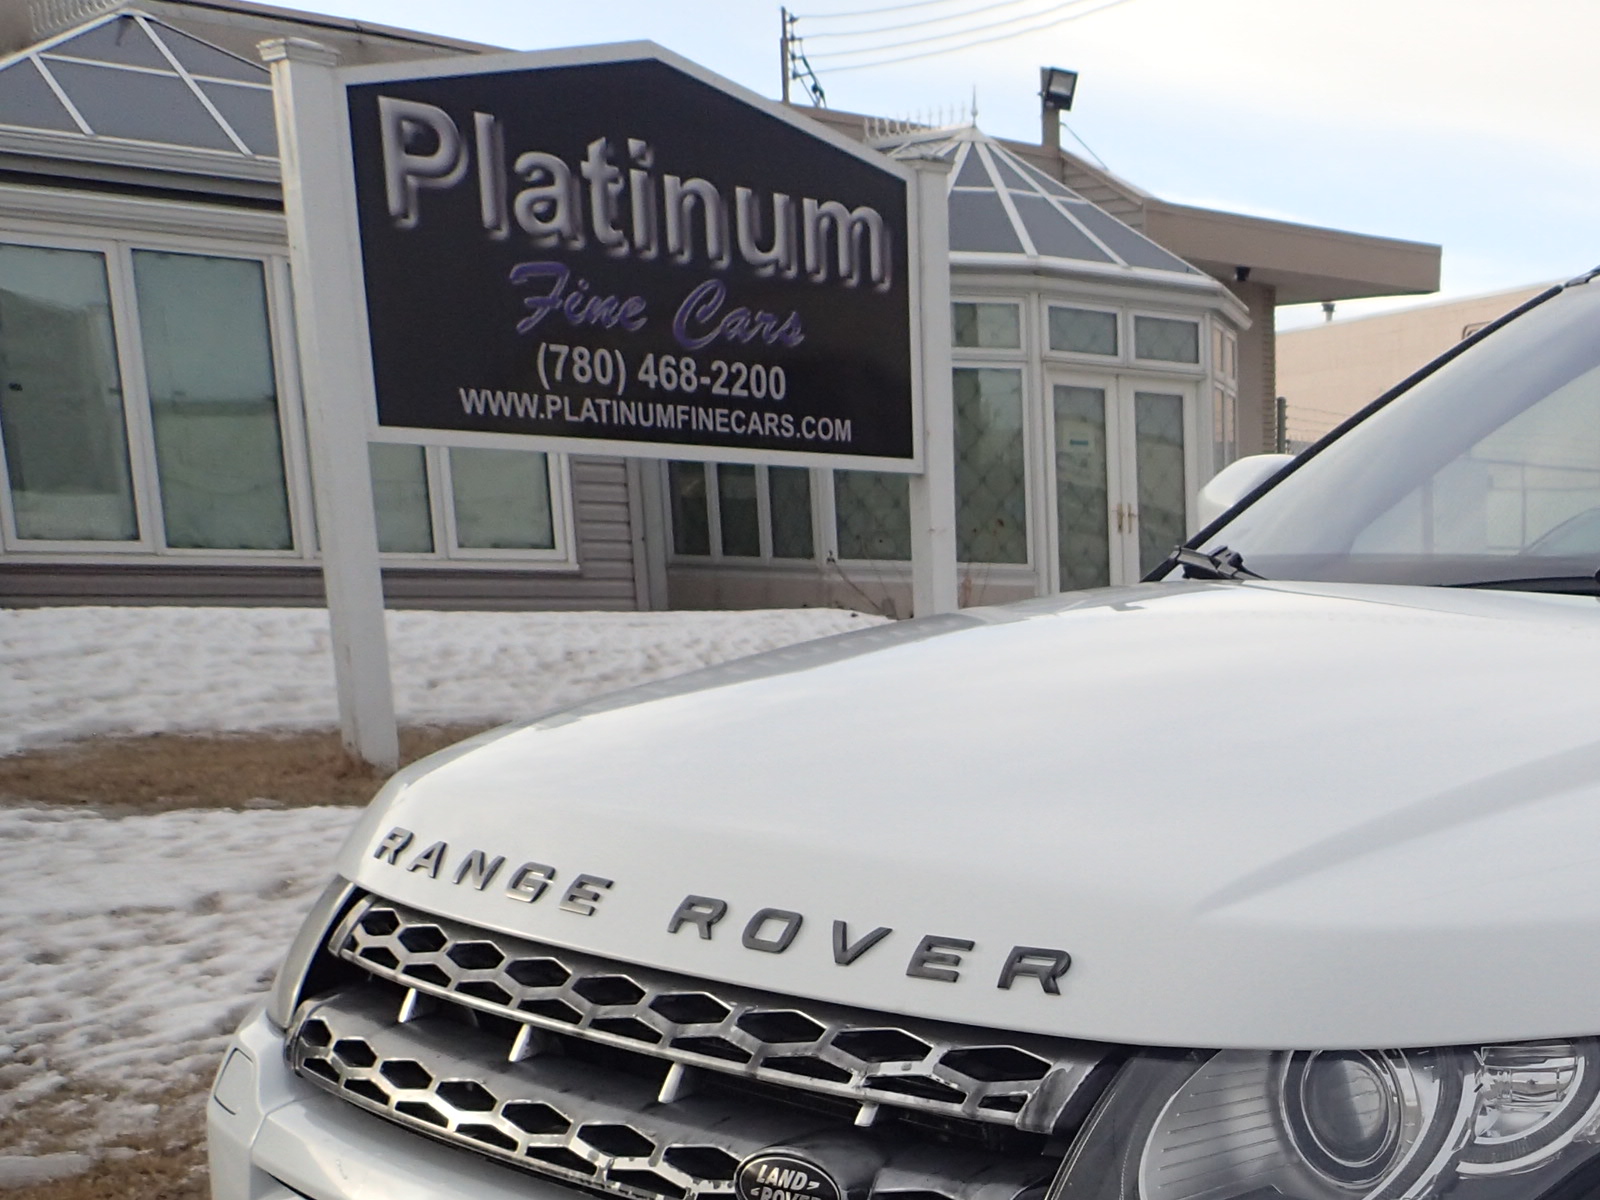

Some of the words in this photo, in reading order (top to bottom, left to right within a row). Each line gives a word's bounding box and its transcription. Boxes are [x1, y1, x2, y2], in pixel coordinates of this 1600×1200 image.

[377, 95, 893, 294] Platinum
[509, 261, 648, 334] Fine
[672, 278, 805, 350] Cars
[536, 341, 627, 396] (780)
[637, 352, 787, 400] 468-2200
[459, 387, 852, 442] WWW.PLATINUMFINECARS.COM
[373, 826, 614, 916] RANGE
[667, 894, 1073, 997] ROVER
[755, 1164, 808, 1191] LAND
